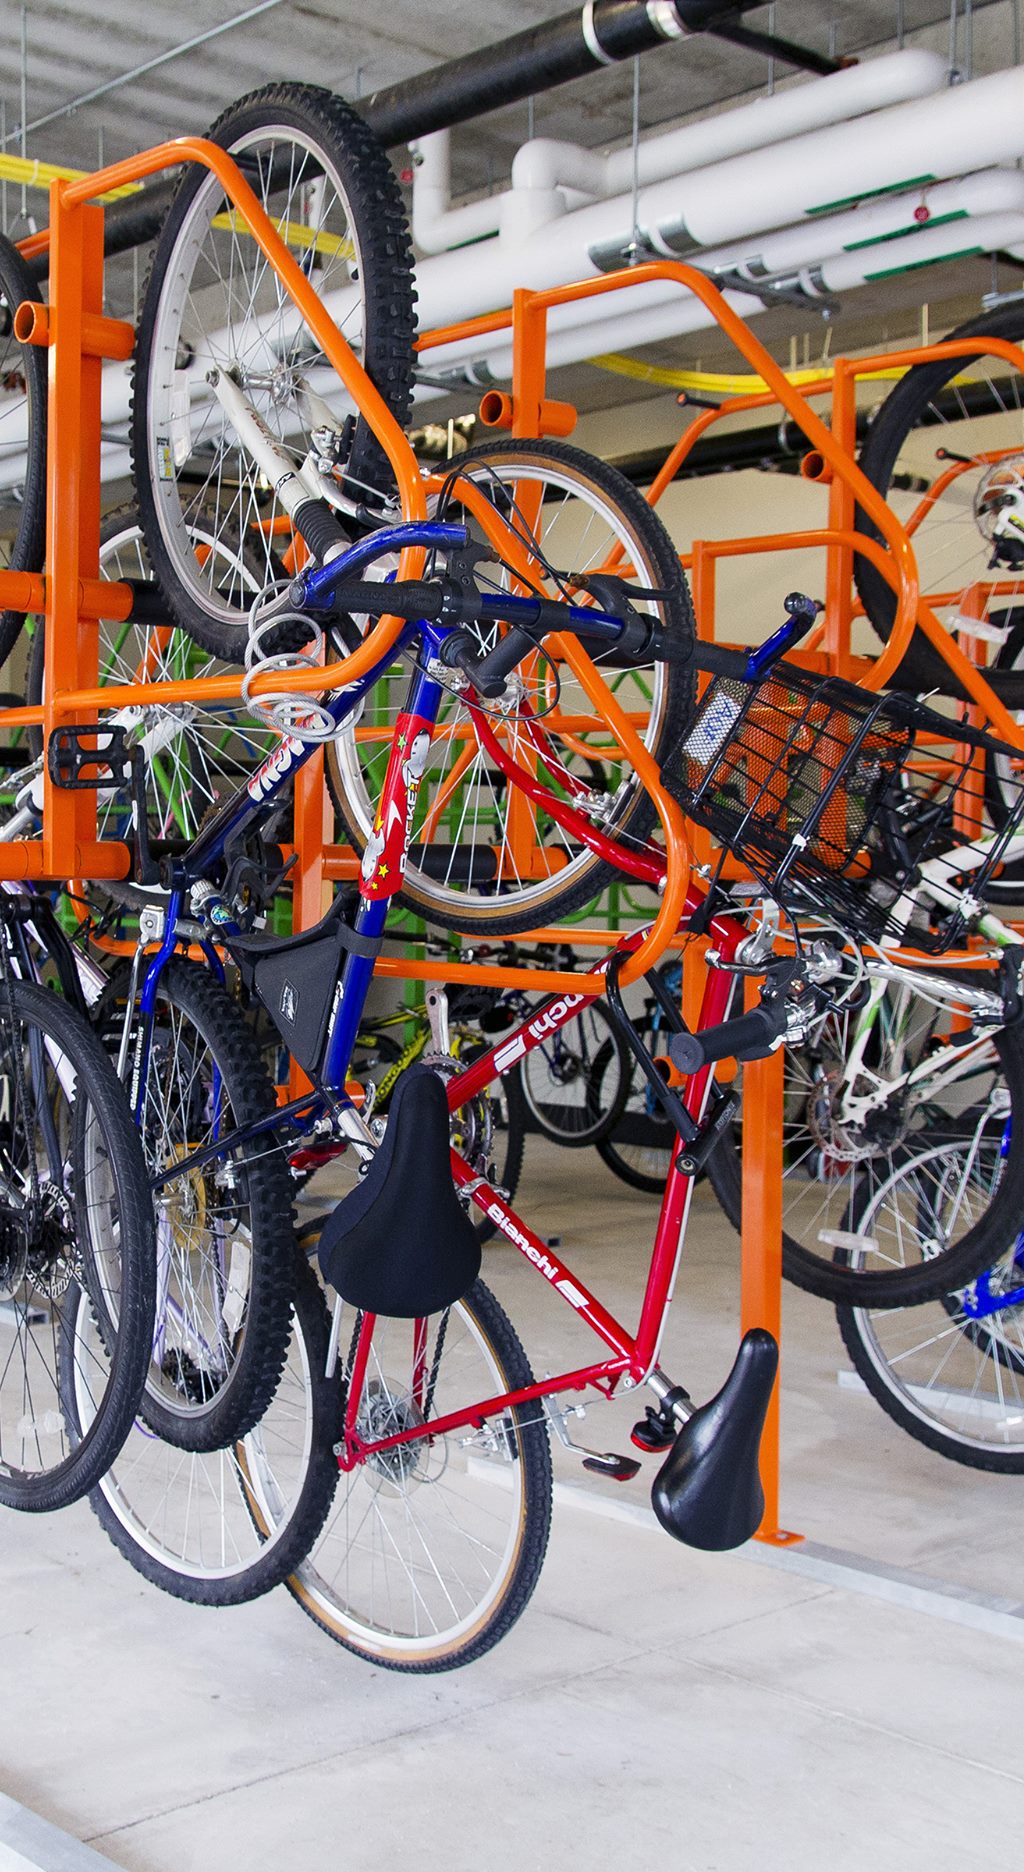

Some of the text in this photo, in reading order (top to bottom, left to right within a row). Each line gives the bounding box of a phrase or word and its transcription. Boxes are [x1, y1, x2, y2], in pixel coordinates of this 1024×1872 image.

[129, 1025, 145, 1111] SHIMANO EQUIPPED
[487, 1203, 559, 1280] Bianchi
